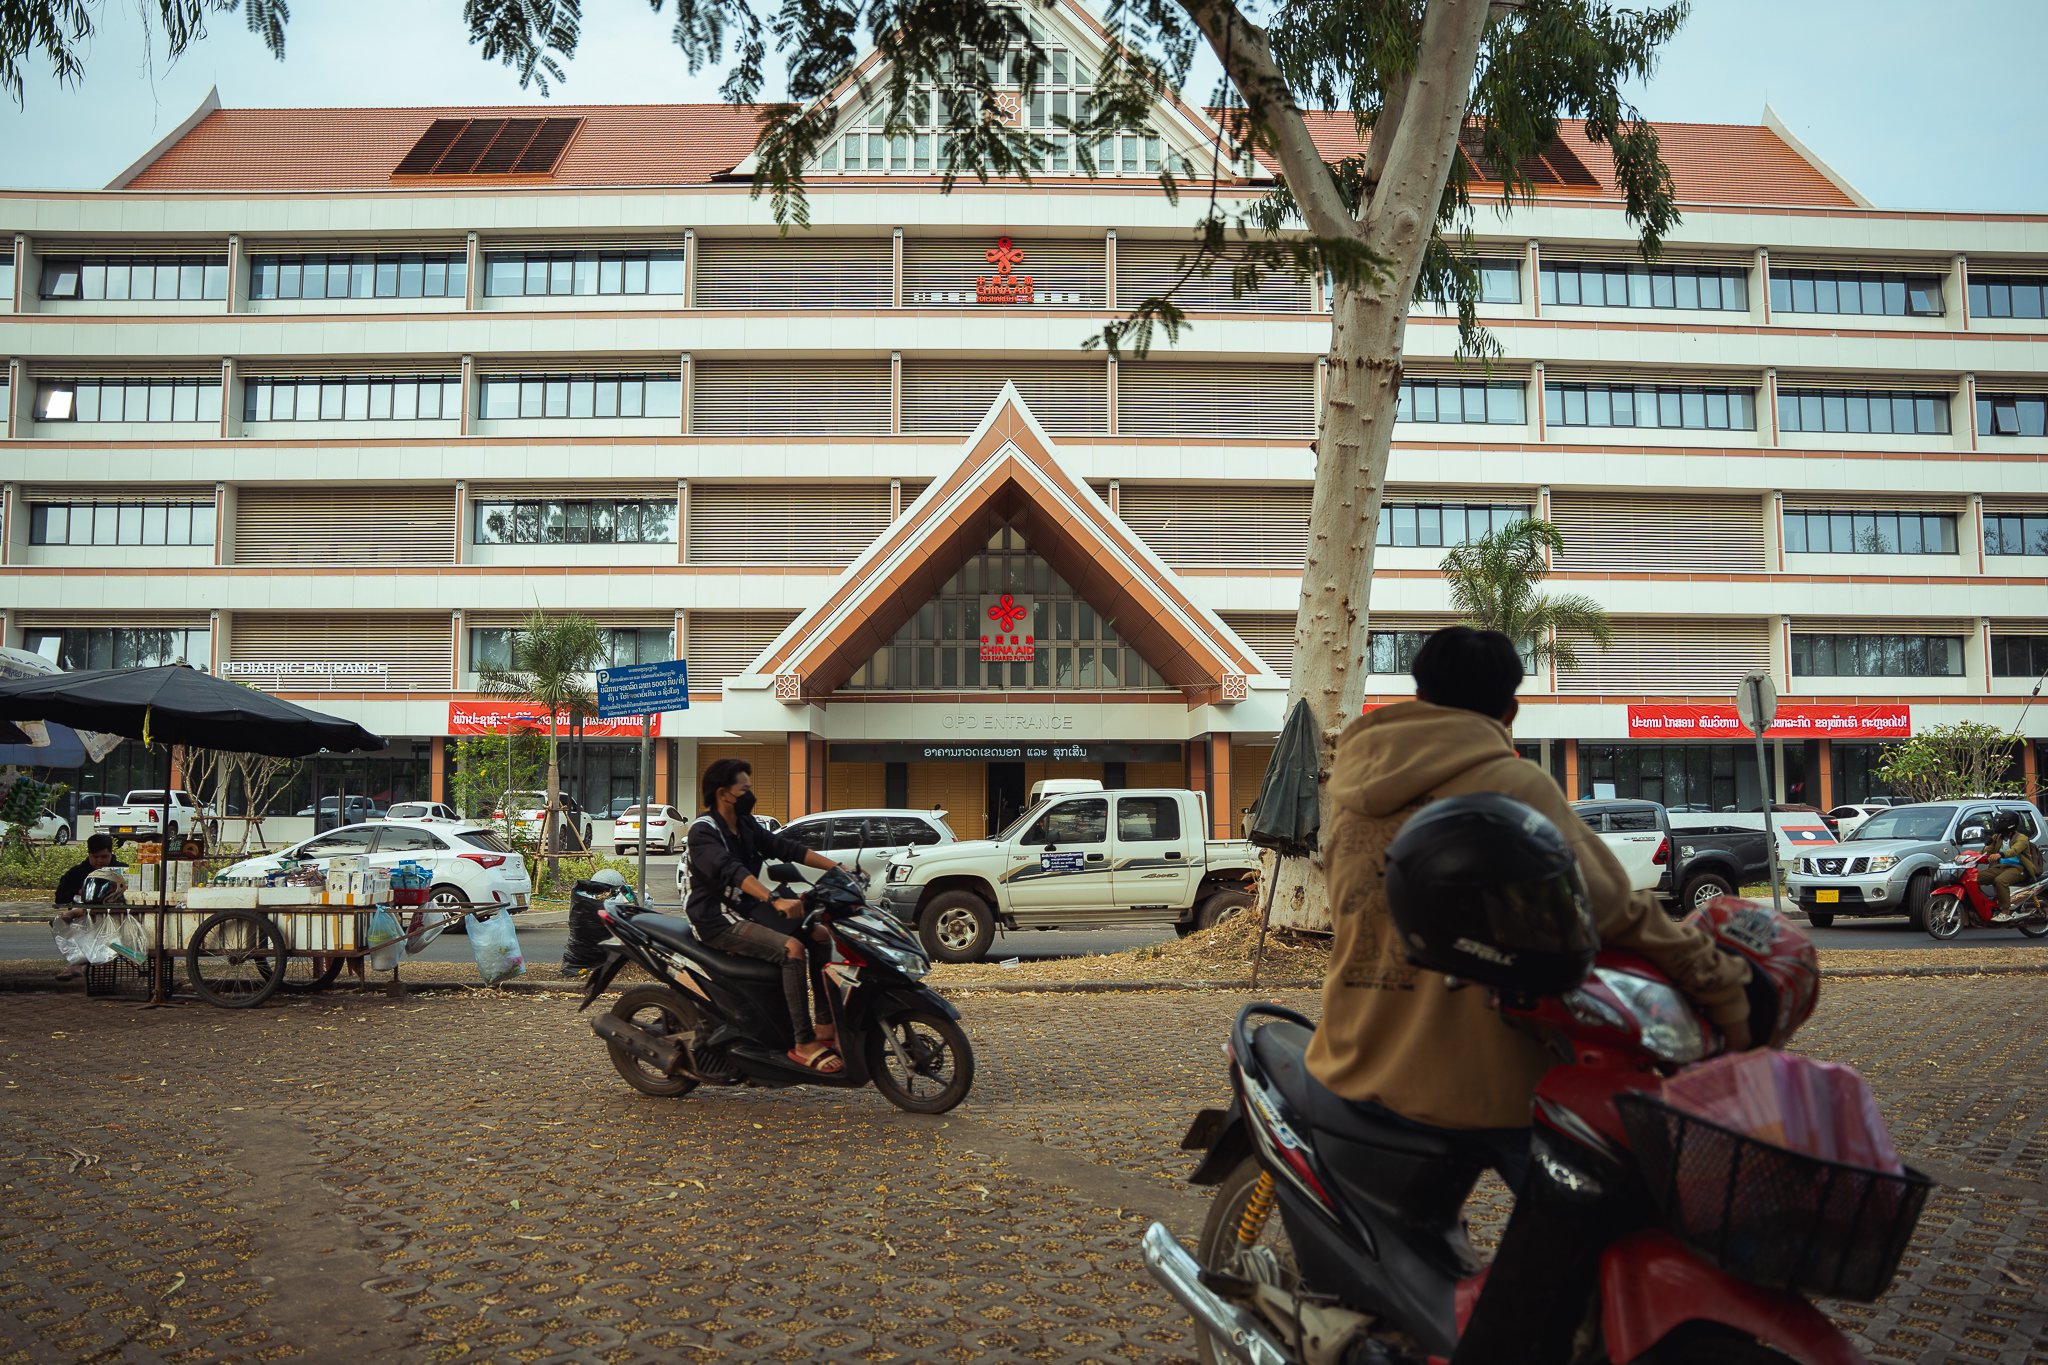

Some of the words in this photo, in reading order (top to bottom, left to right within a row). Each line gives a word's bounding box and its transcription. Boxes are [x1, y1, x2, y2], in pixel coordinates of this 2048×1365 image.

[976, 286, 1011, 294] CHINA
[1012, 286, 1033, 294] AID
[980, 645, 1014, 655] CHINA
[1015, 645, 1035, 655] AID
[220, 662, 300, 675] PEDIATRIC
[303, 662, 388, 674] ENTRANCE
[600, 672, 608, 683] P
[652, 680, 667, 688] 5000
[942, 715, 978, 729] OPD
[983, 715, 1073, 730] ENTRANCE
[1632, 715, 1662, 728] ປະທານ
[1663, 714, 1694, 728] ໄກສອນ
[1699, 715, 1739, 728] ພົມວິຫານ
[1027, 748, 1048, 757] ແລະ
